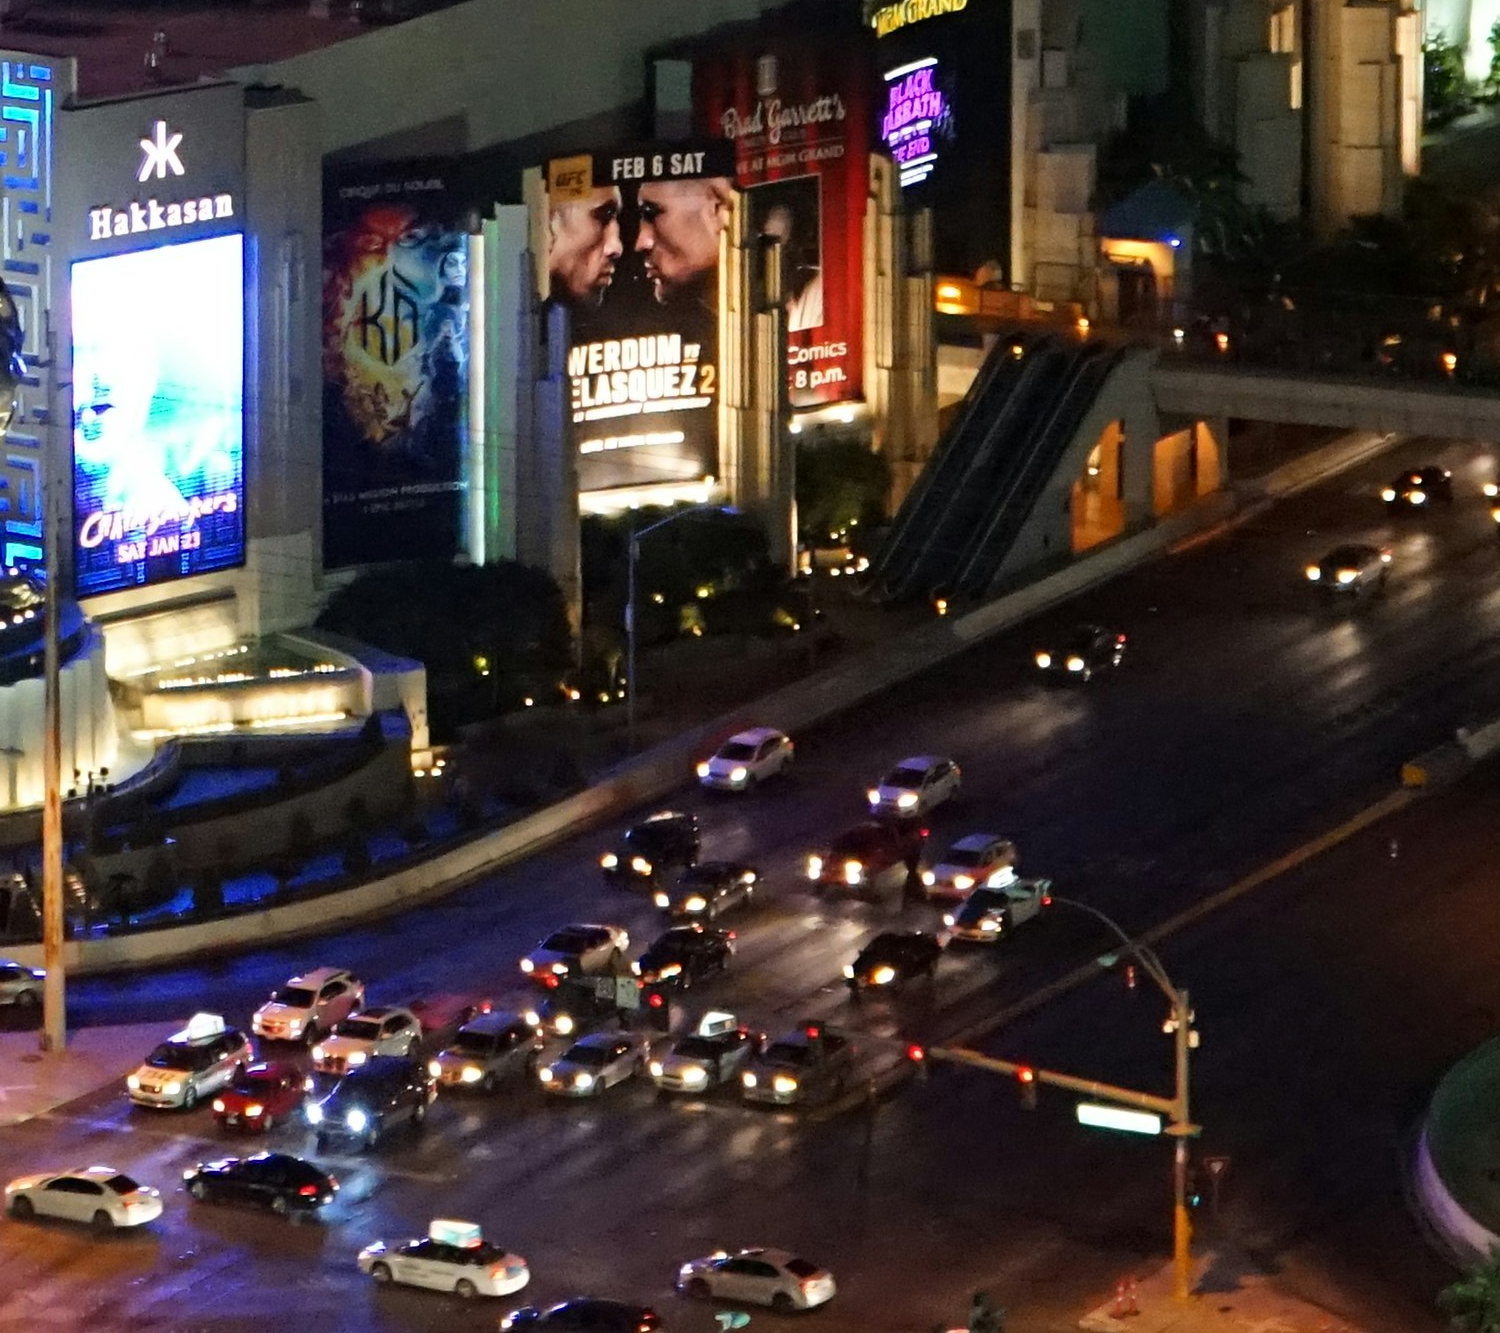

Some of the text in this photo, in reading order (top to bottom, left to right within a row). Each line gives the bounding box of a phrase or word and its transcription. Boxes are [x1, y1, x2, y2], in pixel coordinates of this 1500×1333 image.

[889, 68, 934, 107] BLACK
[721, 101, 763, 140] Brad
[767, 93, 846, 145] Garrett's
[612, 151, 706, 181] FEB 6 SAT
[798, 145, 845, 163] GRAND
[89, 193, 234, 241] Hakkasan
[567, 333, 682, 377] WERDUM
[787, 341, 848, 365] Comics
[572, 364, 698, 410] ELASQUEZ
[700, 364, 716, 395] 2
[794, 366, 847, 389] 8 p.m.
[117, 541, 147, 564] SAT
[148, 533, 180, 557] JAN
